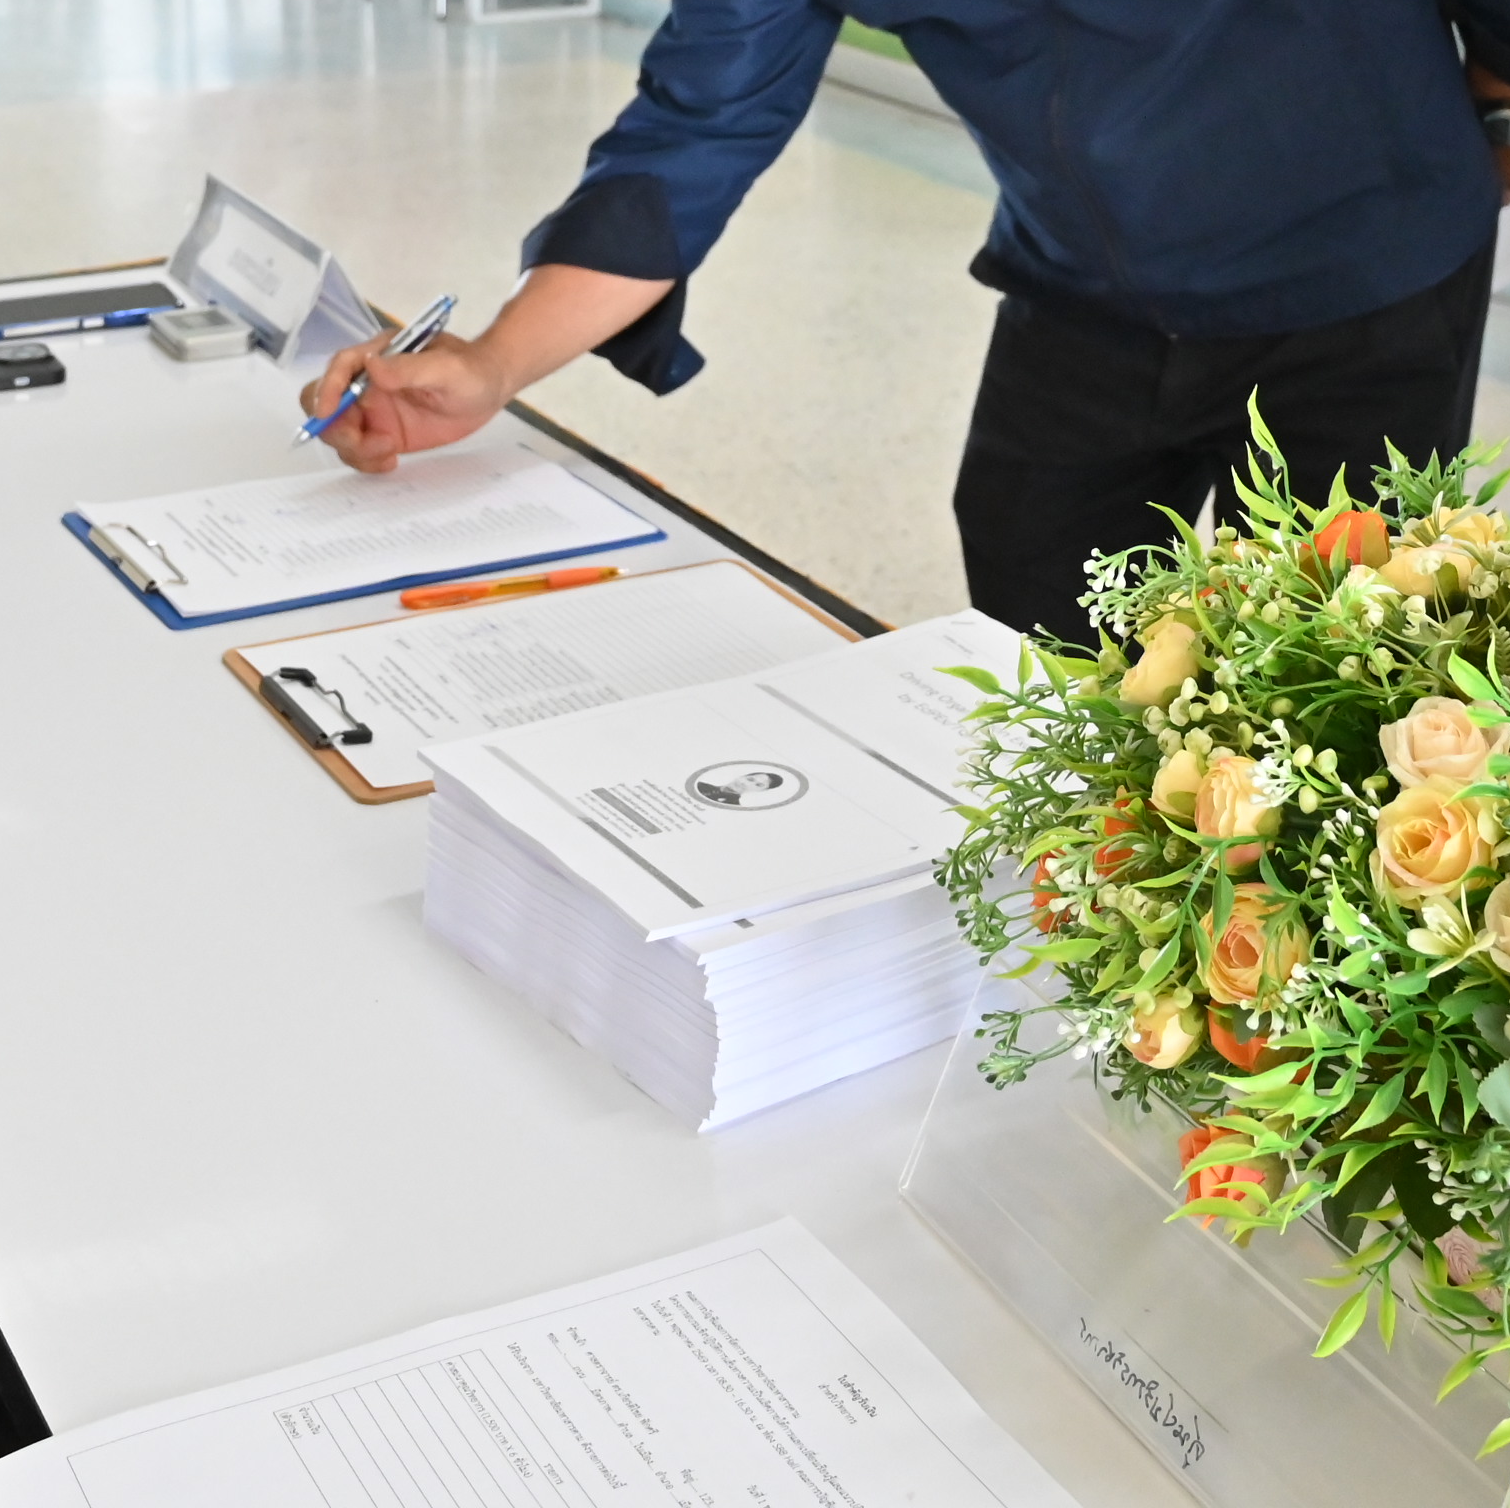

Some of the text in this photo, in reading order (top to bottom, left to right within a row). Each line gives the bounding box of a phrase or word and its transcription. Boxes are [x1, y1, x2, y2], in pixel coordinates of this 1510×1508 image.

[817, 1384, 857, 1424] สำหรับวิทยากร
[837, 1374, 878, 1418] ใบสำคัญรับเงิน
